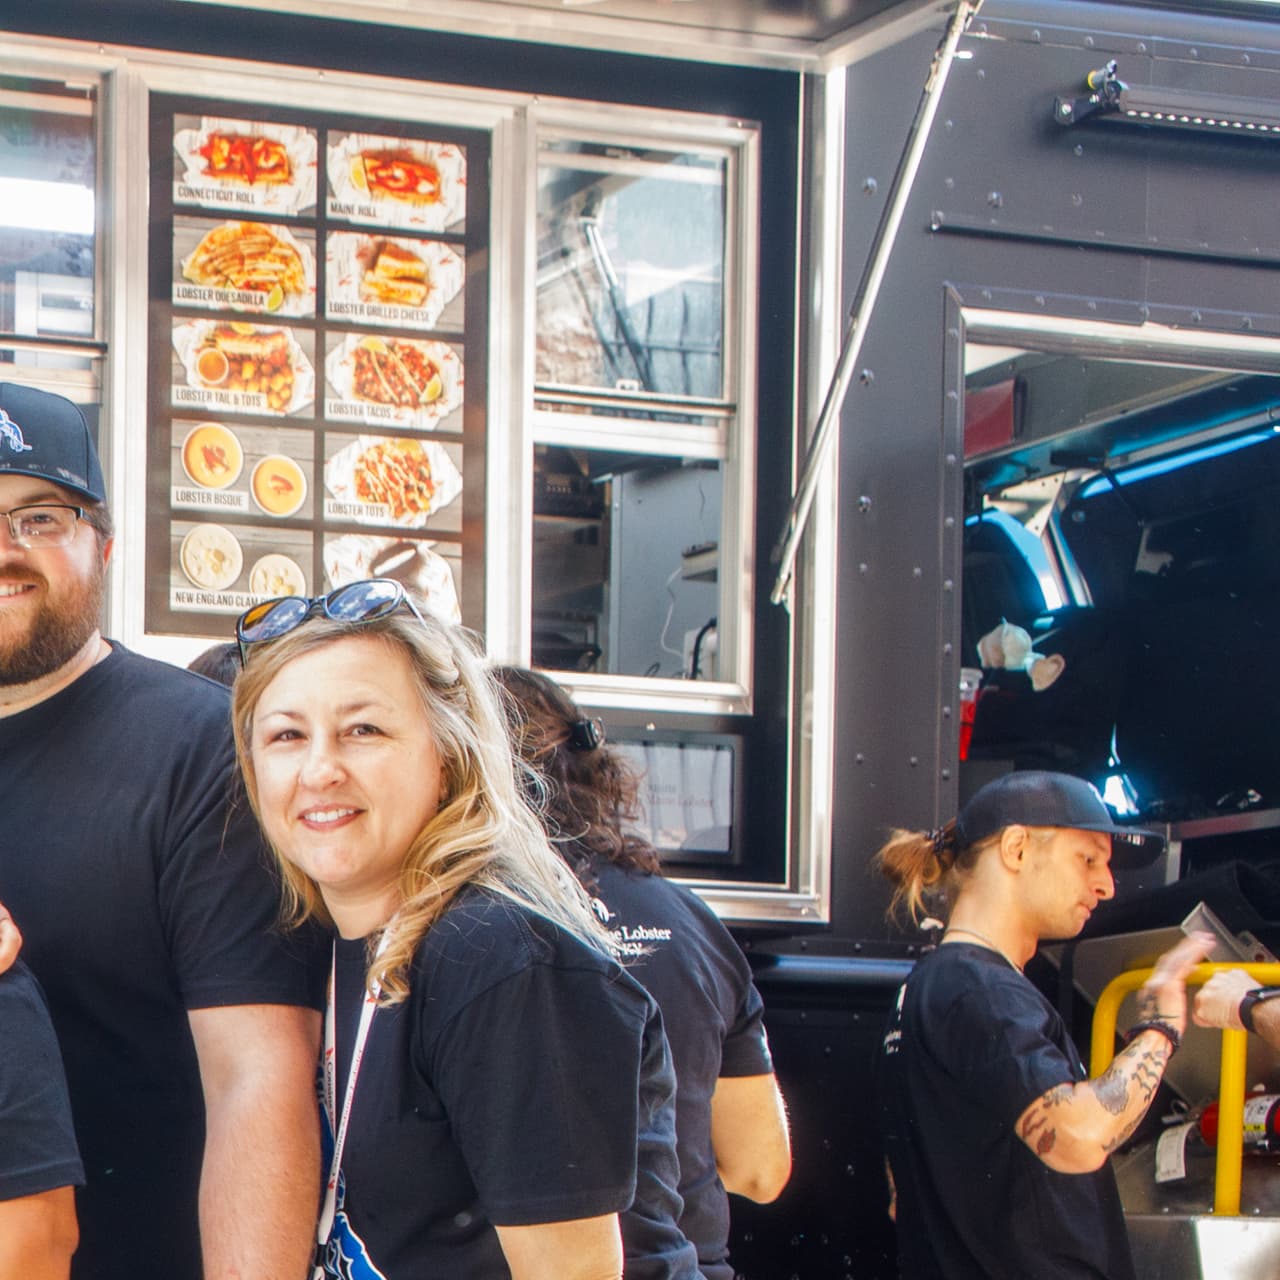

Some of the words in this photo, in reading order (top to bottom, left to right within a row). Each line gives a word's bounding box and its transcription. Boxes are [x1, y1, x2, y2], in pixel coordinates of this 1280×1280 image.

[178, 185, 233, 202] CONNECTICUT
[236, 190, 255, 205] ROLL
[330, 201, 355, 216] MAINE
[358, 205, 377, 218] ROLL
[176, 287, 214, 302] LOBSTER
[215, 289, 265, 306] QUESADILLA
[329, 301, 365, 316] LOBSTER
[366, 305, 399, 320] GRILLED
[401, 307, 429, 322] CHEESE
[176, 388, 212, 403] LOBSTER
[215, 391, 230, 405] TAIL
[241, 393, 261, 407] TOTS
[328, 401, 364, 417] LOBSTER
[366, 404, 391, 418] TACOS
[175, 489, 212, 505] LOBSTER
[214, 492, 243, 507] BISQUE
[327, 502, 364, 517] LOBSTER
[365, 504, 385, 518] TOTS
[176, 591, 194, 604] NEW
[196, 592, 234, 607] ENGLAND
[235, 595, 259, 608] CLAM
[621, 924, 673, 941] Lobster
